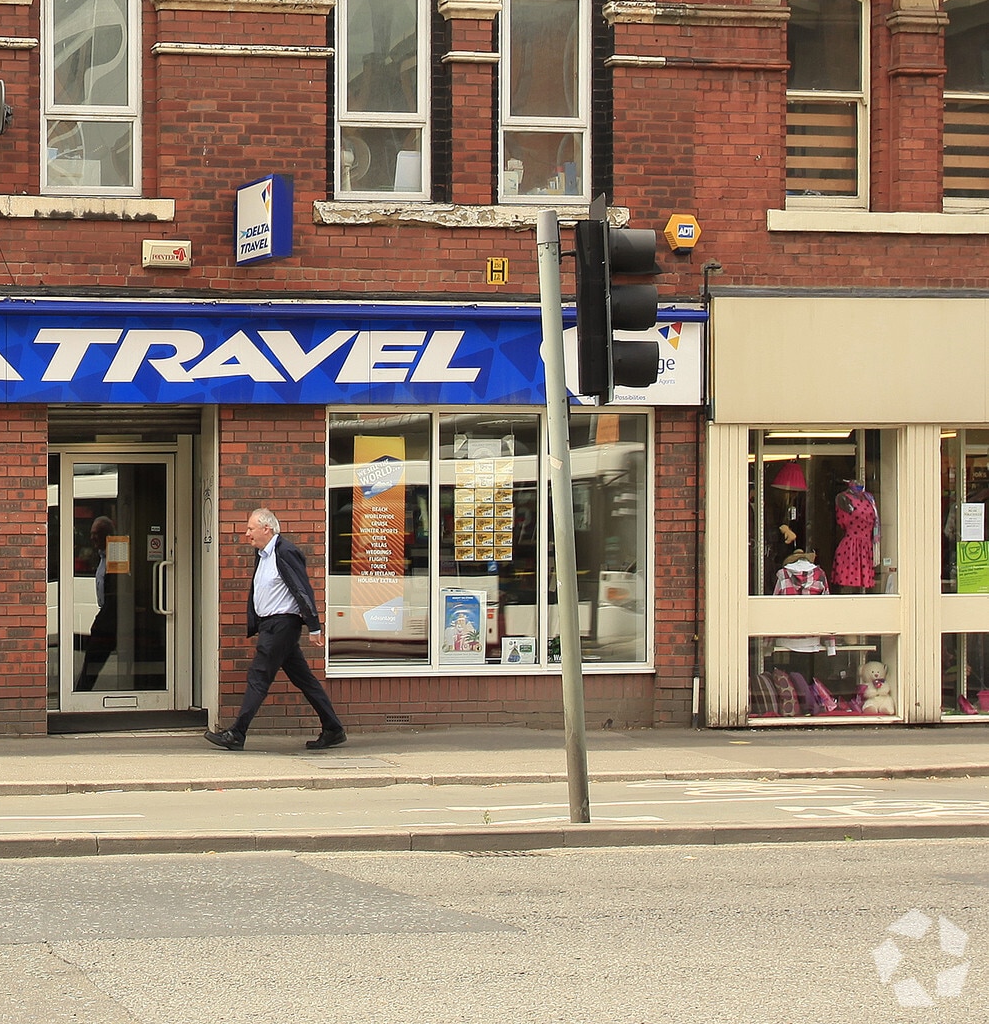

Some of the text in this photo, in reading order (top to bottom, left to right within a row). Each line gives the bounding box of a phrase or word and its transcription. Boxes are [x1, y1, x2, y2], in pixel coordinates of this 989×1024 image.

[246, 223, 270, 239] DELTA
[678, 227, 693, 236] ADT
[240, 238, 269, 255] TRAVEL
[491, 260, 505, 281] H
[33, 328, 481, 383] TRAVEL
